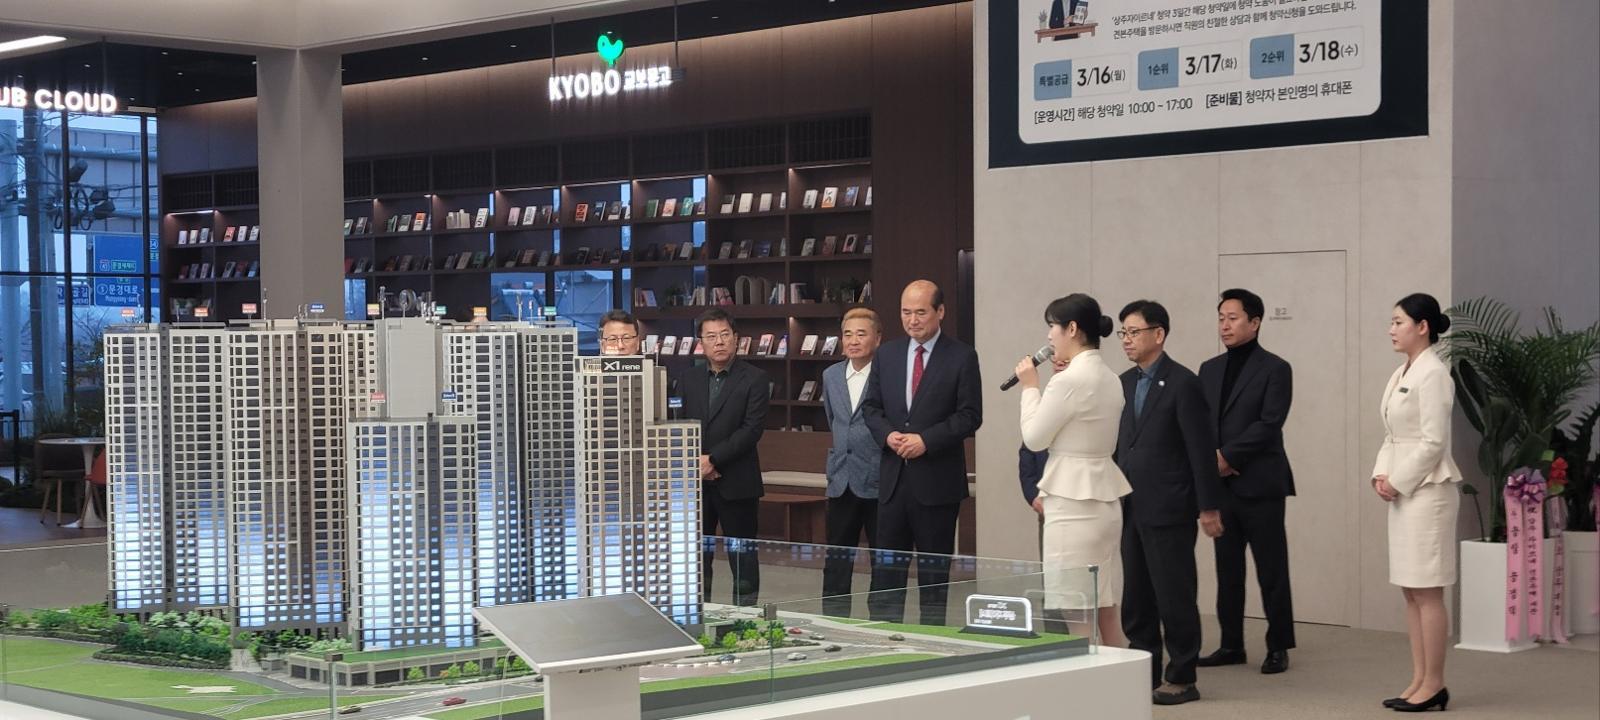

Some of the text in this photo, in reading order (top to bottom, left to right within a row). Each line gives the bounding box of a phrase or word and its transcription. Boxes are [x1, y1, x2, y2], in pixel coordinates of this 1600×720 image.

[1113, 1, 1357, 40] 견본주택을 방문하시면 직원의 친절한 상담과 함께 청약신청을 도와드립니다.
[1157, 9, 1171, 20] 청약
[1172, 7, 1191, 18] 3일간
[1261, 50, 1285, 63] 2순위
[1148, 63, 1169, 76] 1순위
[549, 65, 674, 101] KYOBO 교보문고
[1039, 73, 1068, 87] 특별공급
[34, 88, 117, 113] CLOUD
[1034, 107, 1075, 124] [운영시간]
[1077, 106, 1095, 119] 해당
[1097, 103, 1124, 118] 청약일
[1128, 101, 1155, 114] 10:00
[1166, 98, 1193, 110] 17:00
[1206, 91, 1242, 109] [준비물]
[1245, 88, 1275, 104] 청약자
[1277, 84, 1318, 101] 본인명의
[1320, 80, 1352, 96] 휴대폰
[109, 284, 138, 295] 문경대로
